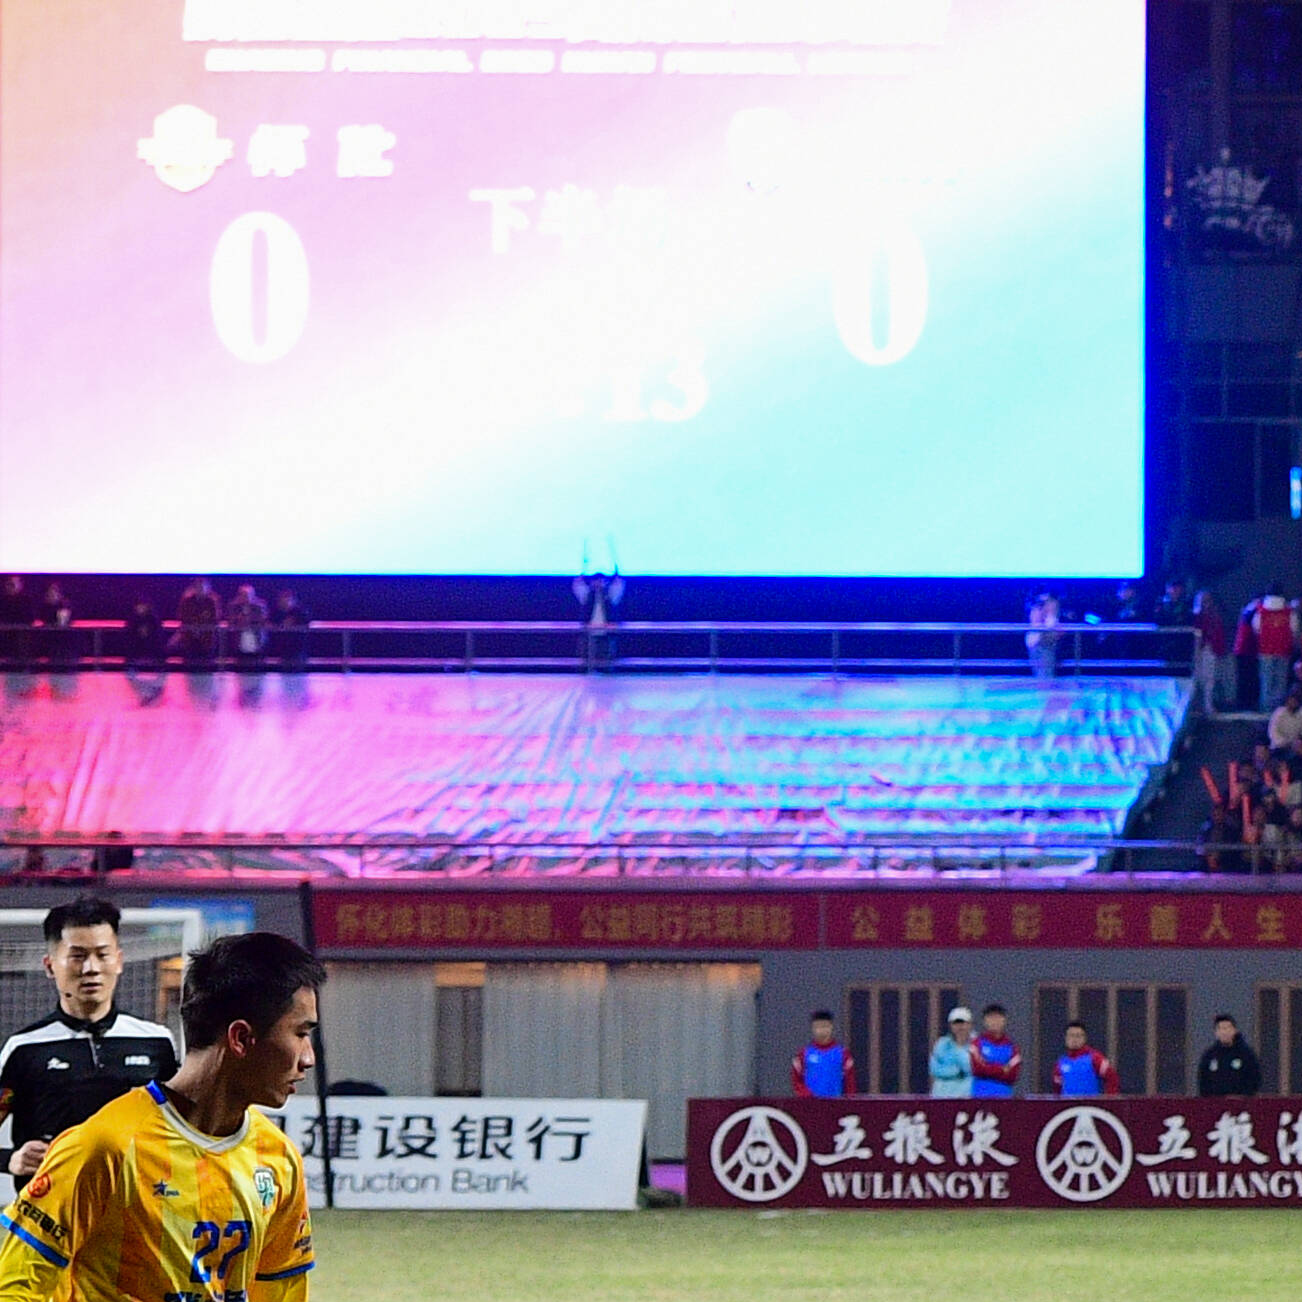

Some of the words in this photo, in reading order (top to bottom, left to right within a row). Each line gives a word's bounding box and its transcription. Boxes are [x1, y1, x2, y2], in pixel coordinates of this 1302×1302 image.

[209, 211, 311, 364] 0
[832, 216, 931, 367] 0
[451, 1168, 529, 1194] Bank
[822, 1172, 1010, 1199] WULIANGYE
